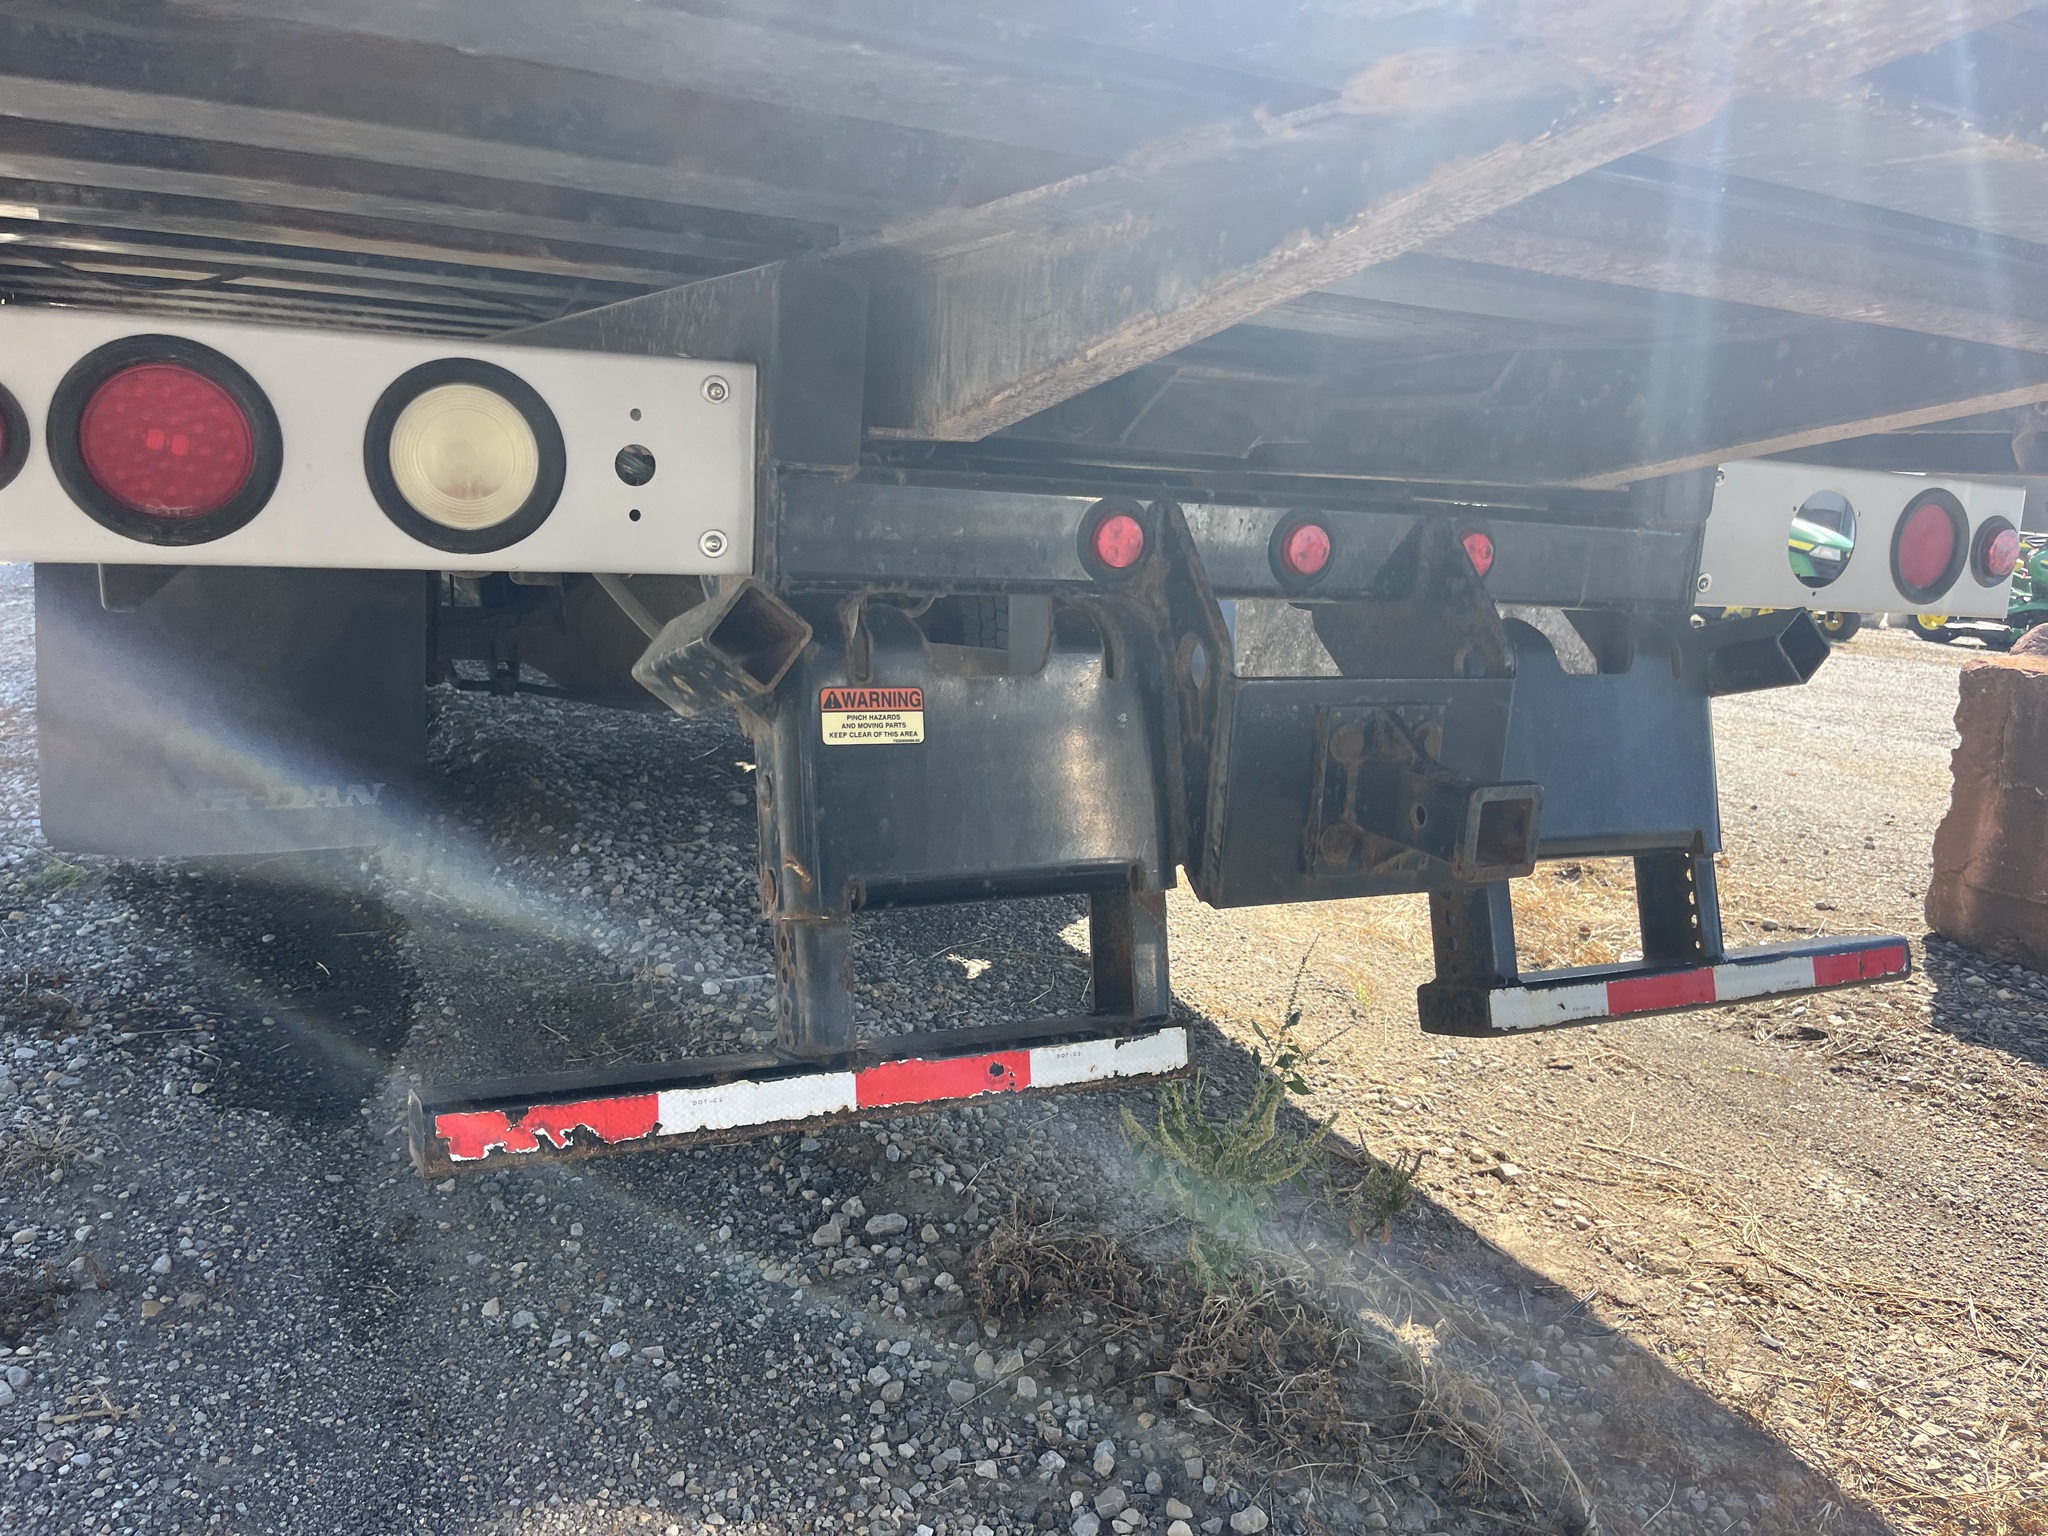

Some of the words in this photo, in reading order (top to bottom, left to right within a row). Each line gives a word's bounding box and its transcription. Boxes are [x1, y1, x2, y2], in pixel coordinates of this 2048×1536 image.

[841, 691, 921, 707] WARNING
[1056, 1051, 1081, 1059] DOT-C2
[692, 1097, 723, 1106] DOT-C2
